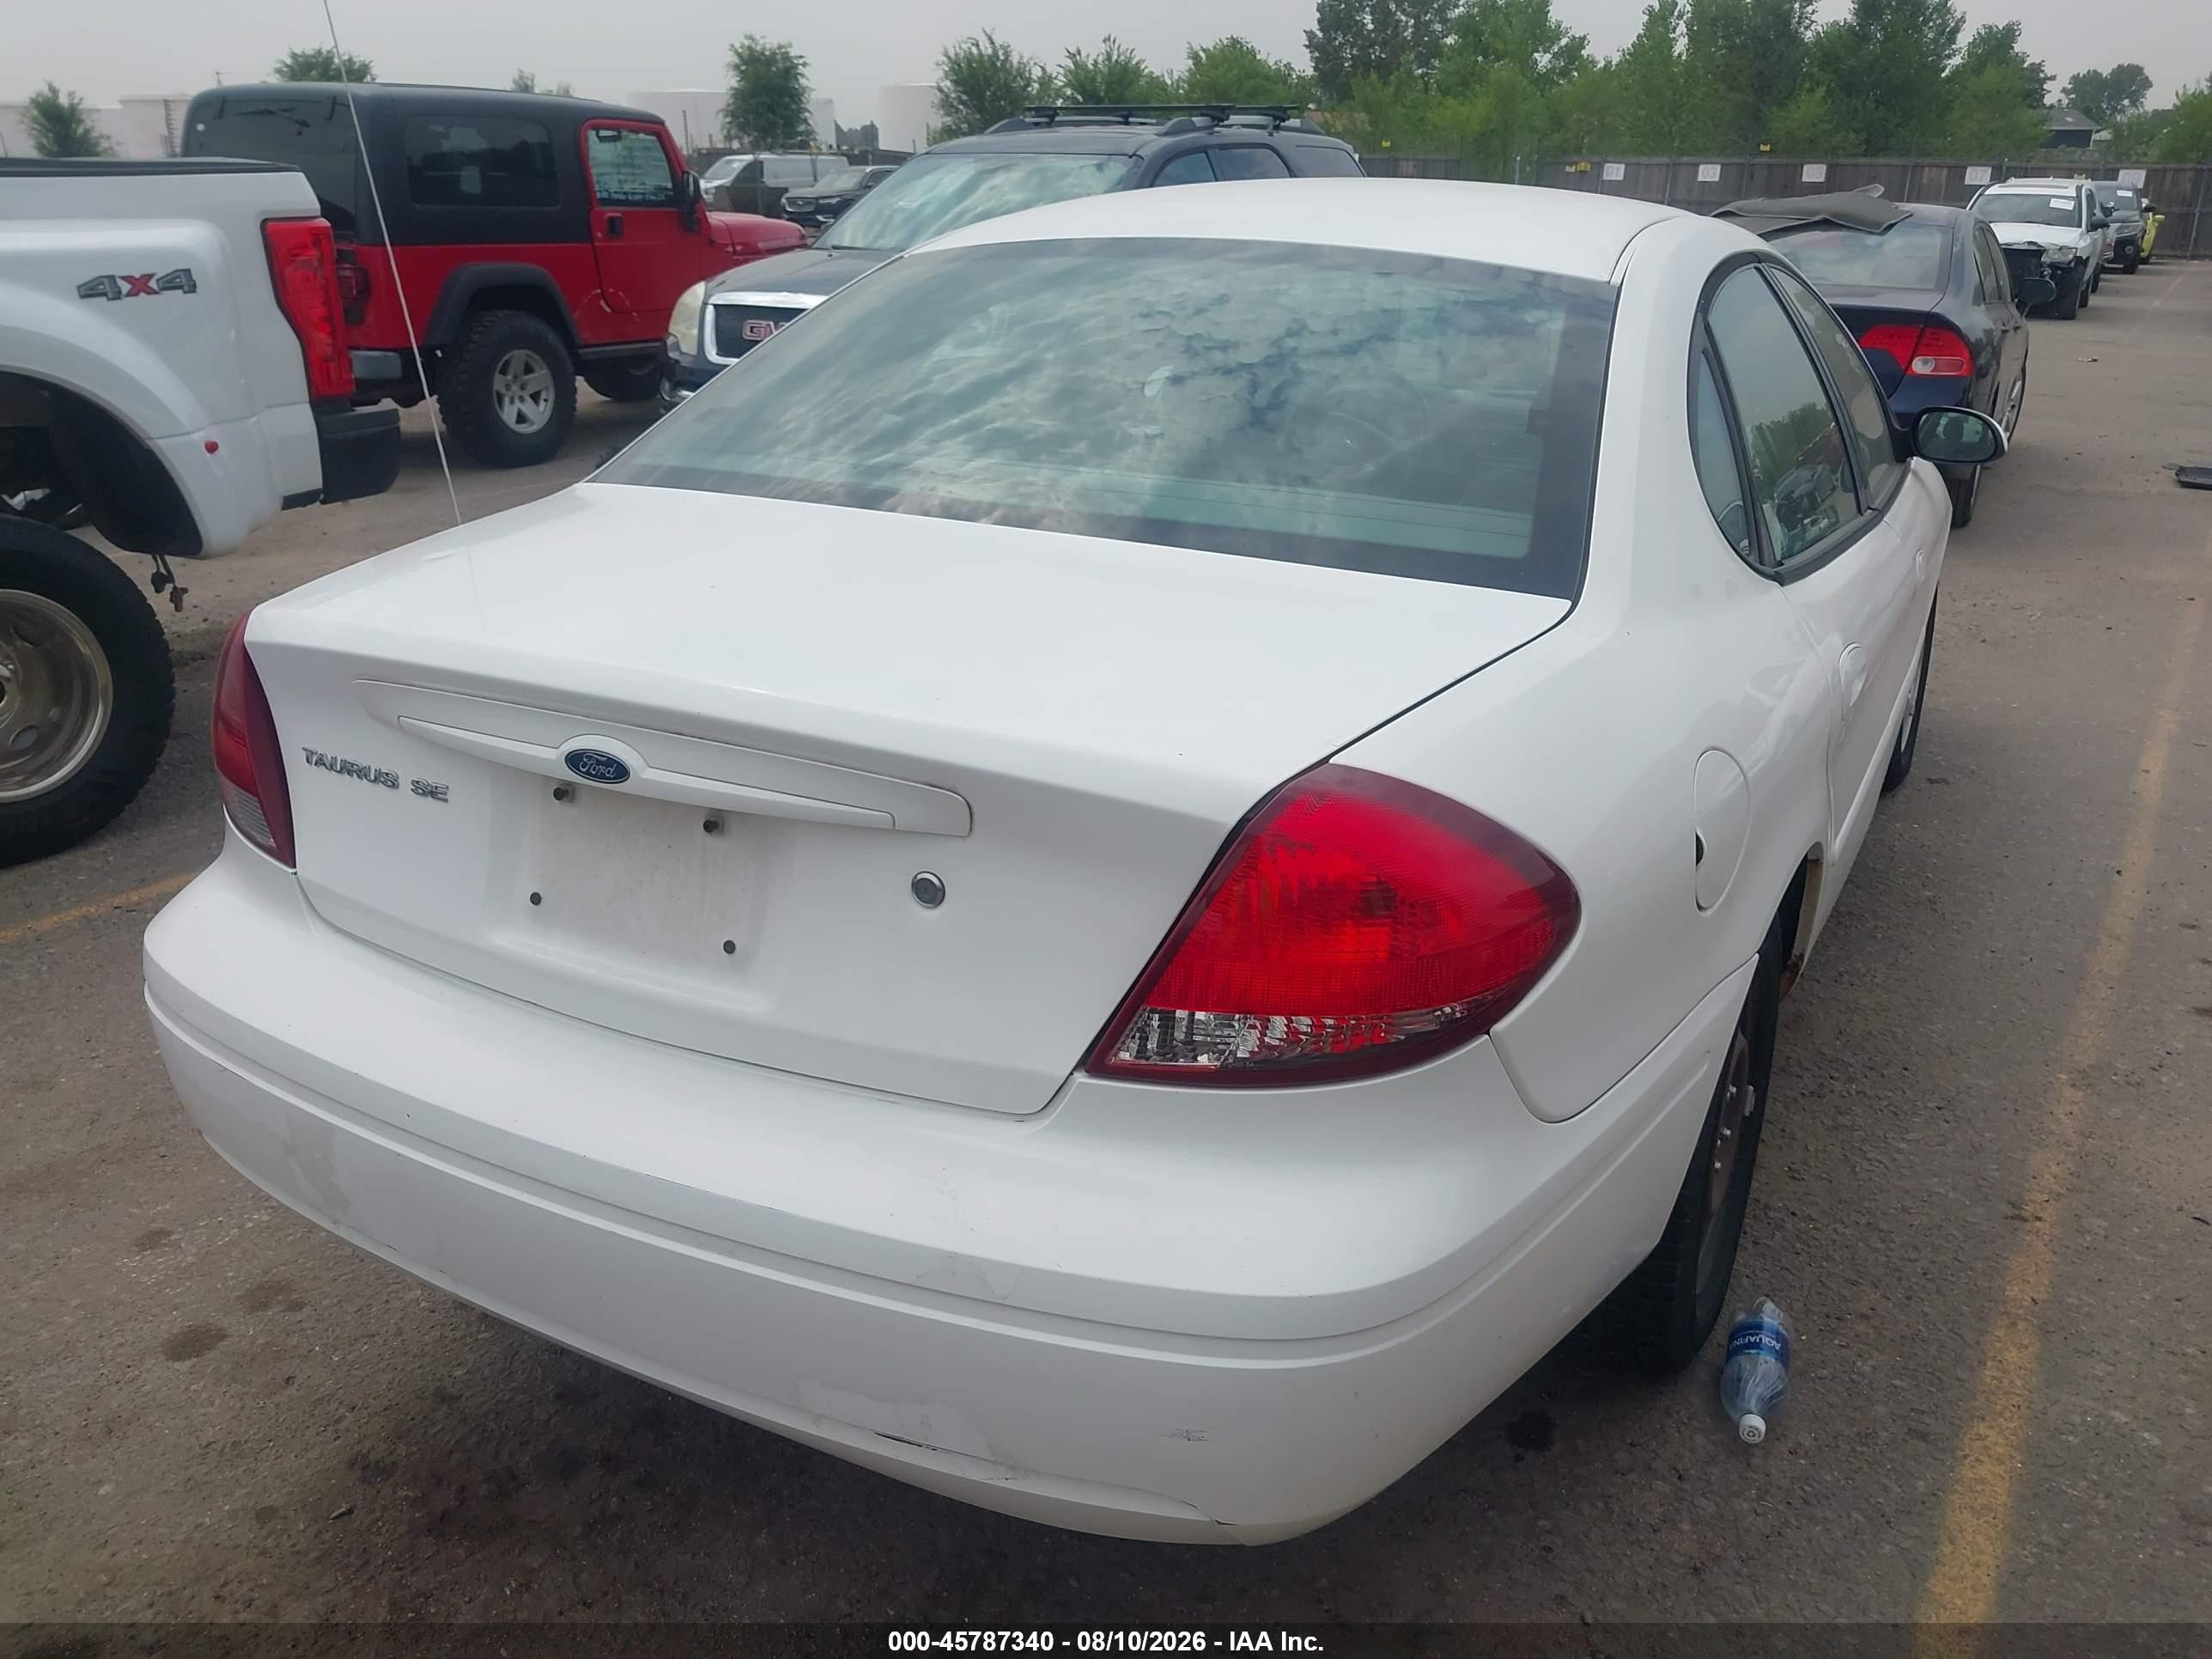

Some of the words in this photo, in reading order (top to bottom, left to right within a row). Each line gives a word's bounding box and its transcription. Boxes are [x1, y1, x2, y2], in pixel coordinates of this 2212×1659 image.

[302, 747, 399, 789] TAURUS
[410, 778, 448, 803] SE
[579, 752, 617, 778] Ford
